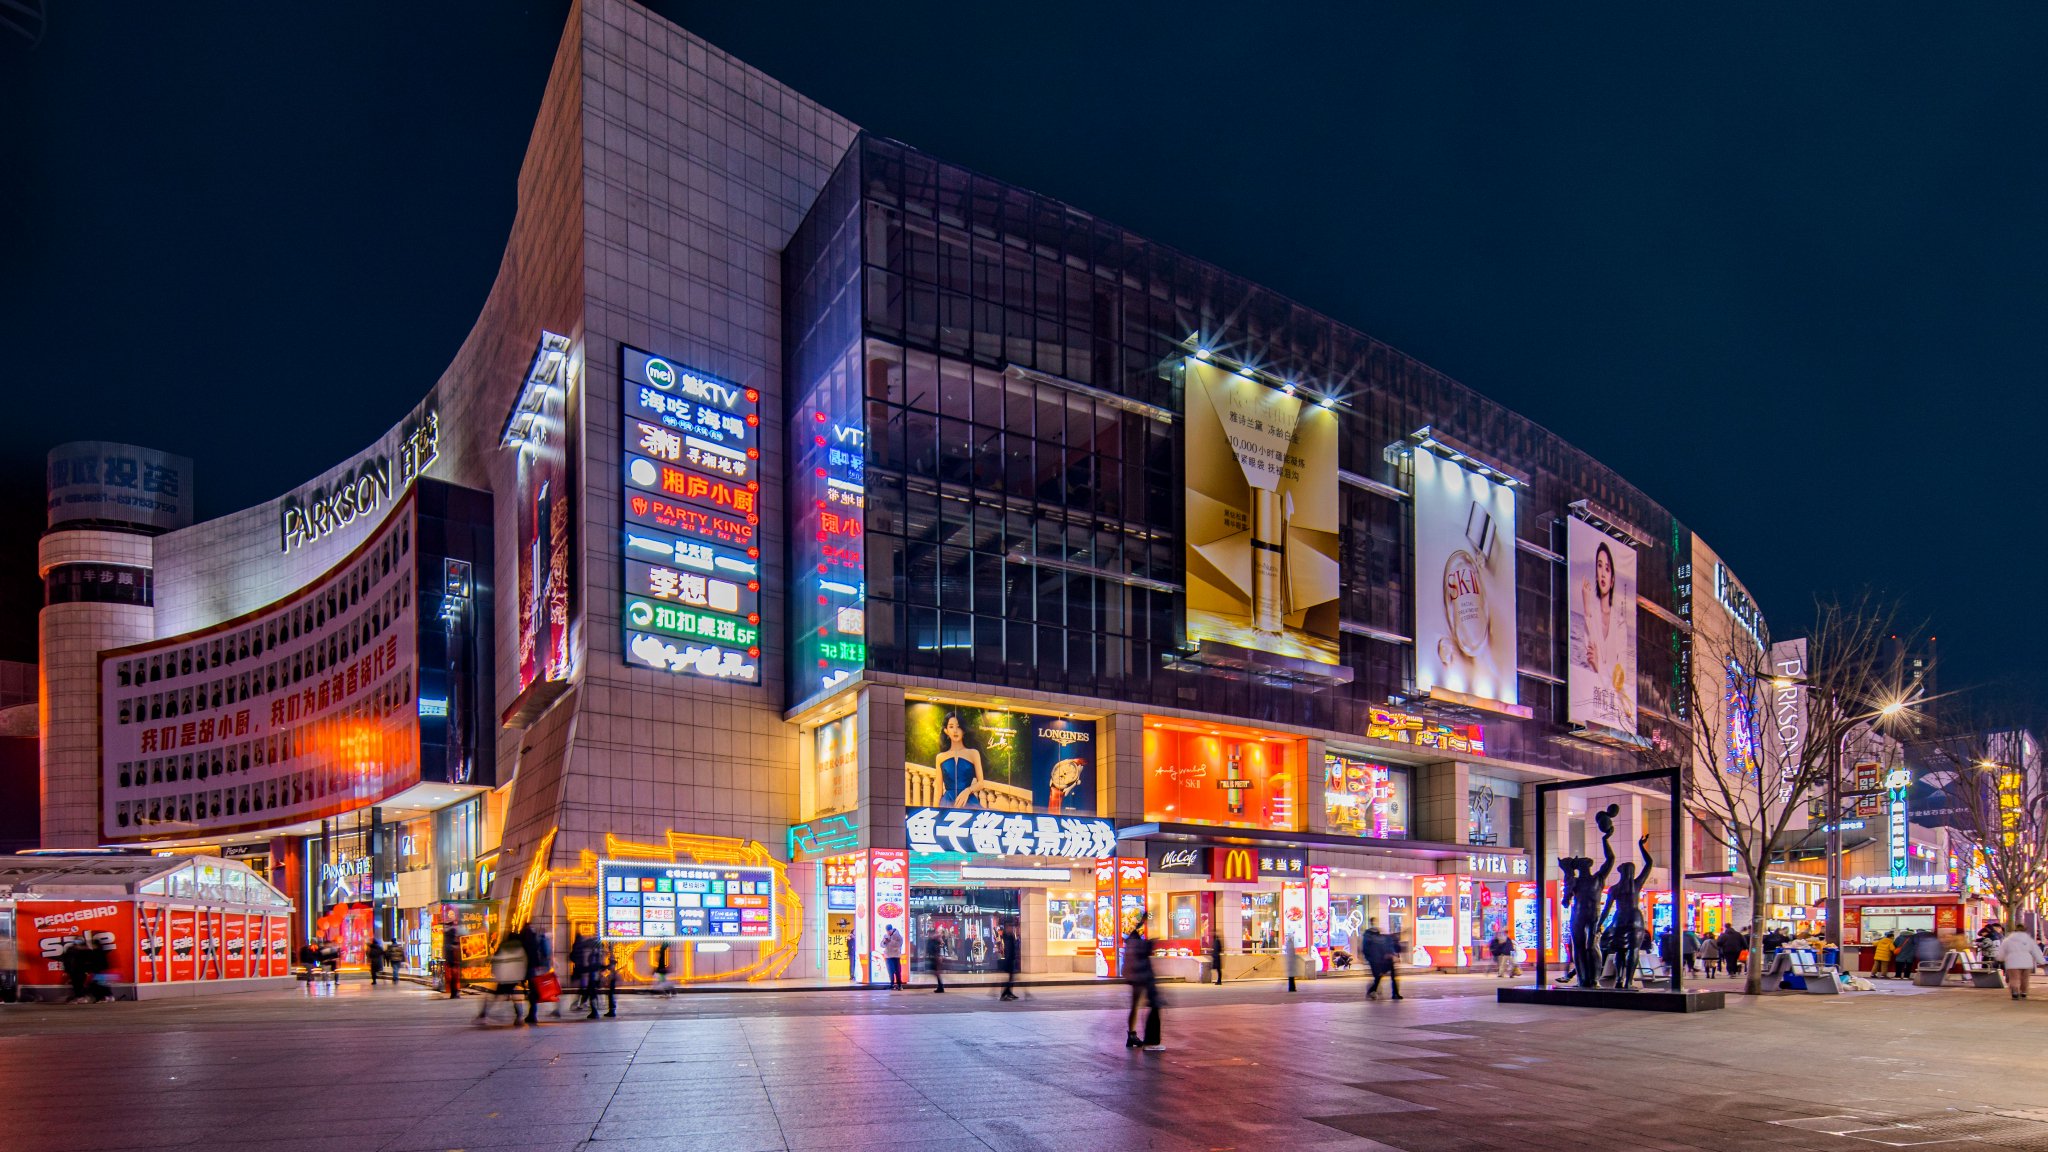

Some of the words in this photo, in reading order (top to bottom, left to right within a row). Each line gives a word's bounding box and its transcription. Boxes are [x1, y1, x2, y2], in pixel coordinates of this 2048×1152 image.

[640, 388, 691, 420] 海吃
[1229, 410, 1263, 432] 雅诗兰黛
[687, 447, 747, 476] 寻湘地带
[662, 467, 754, 513] 湘庐小厨
[282, 459, 392, 554] PARKSON
[653, 501, 708, 525] PARTY
[713, 517, 752, 537] KING
[83, 570, 133, 584] 半步颠
[1448, 569, 1479, 600] SK-II
[656, 607, 736, 642] 扣扣桌球
[737, 629, 756, 645] 5F
[1776, 660, 1800, 757] PRKSON
[1038, 728, 1089, 742] LONGINES
[907, 808, 1117, 858] 鱼子酱实景游戏
[1261, 858, 1303, 871] 麦当劳
[34, 905, 118, 928] PEACEBIRD
